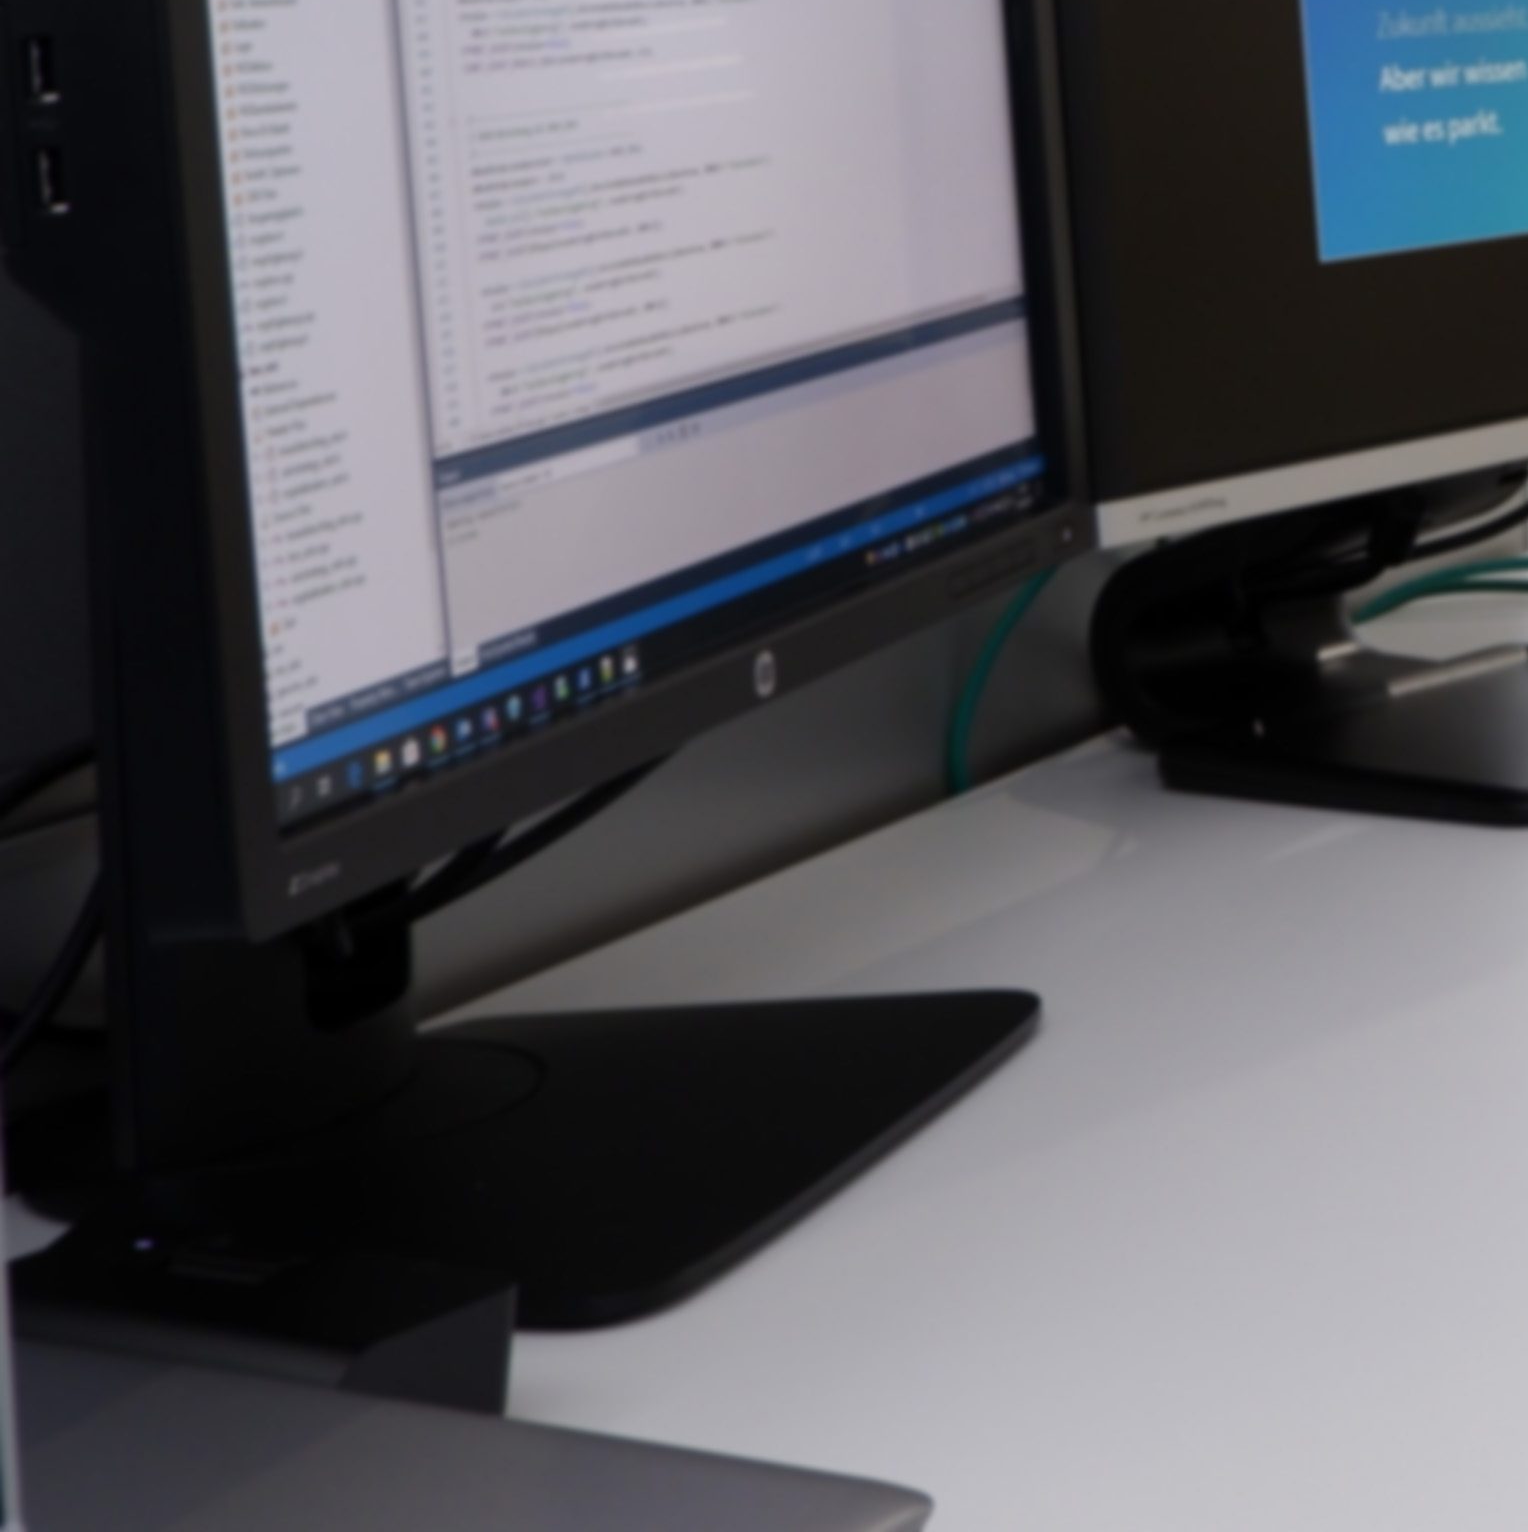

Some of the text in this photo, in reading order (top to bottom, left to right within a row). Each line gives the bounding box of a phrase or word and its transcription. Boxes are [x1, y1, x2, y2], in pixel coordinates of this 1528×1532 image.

[1378, 7, 1447, 39] Zukunft
[1381, 57, 1528, 93] Aber wir wissen
[1384, 109, 1504, 147] wie es parkt.
